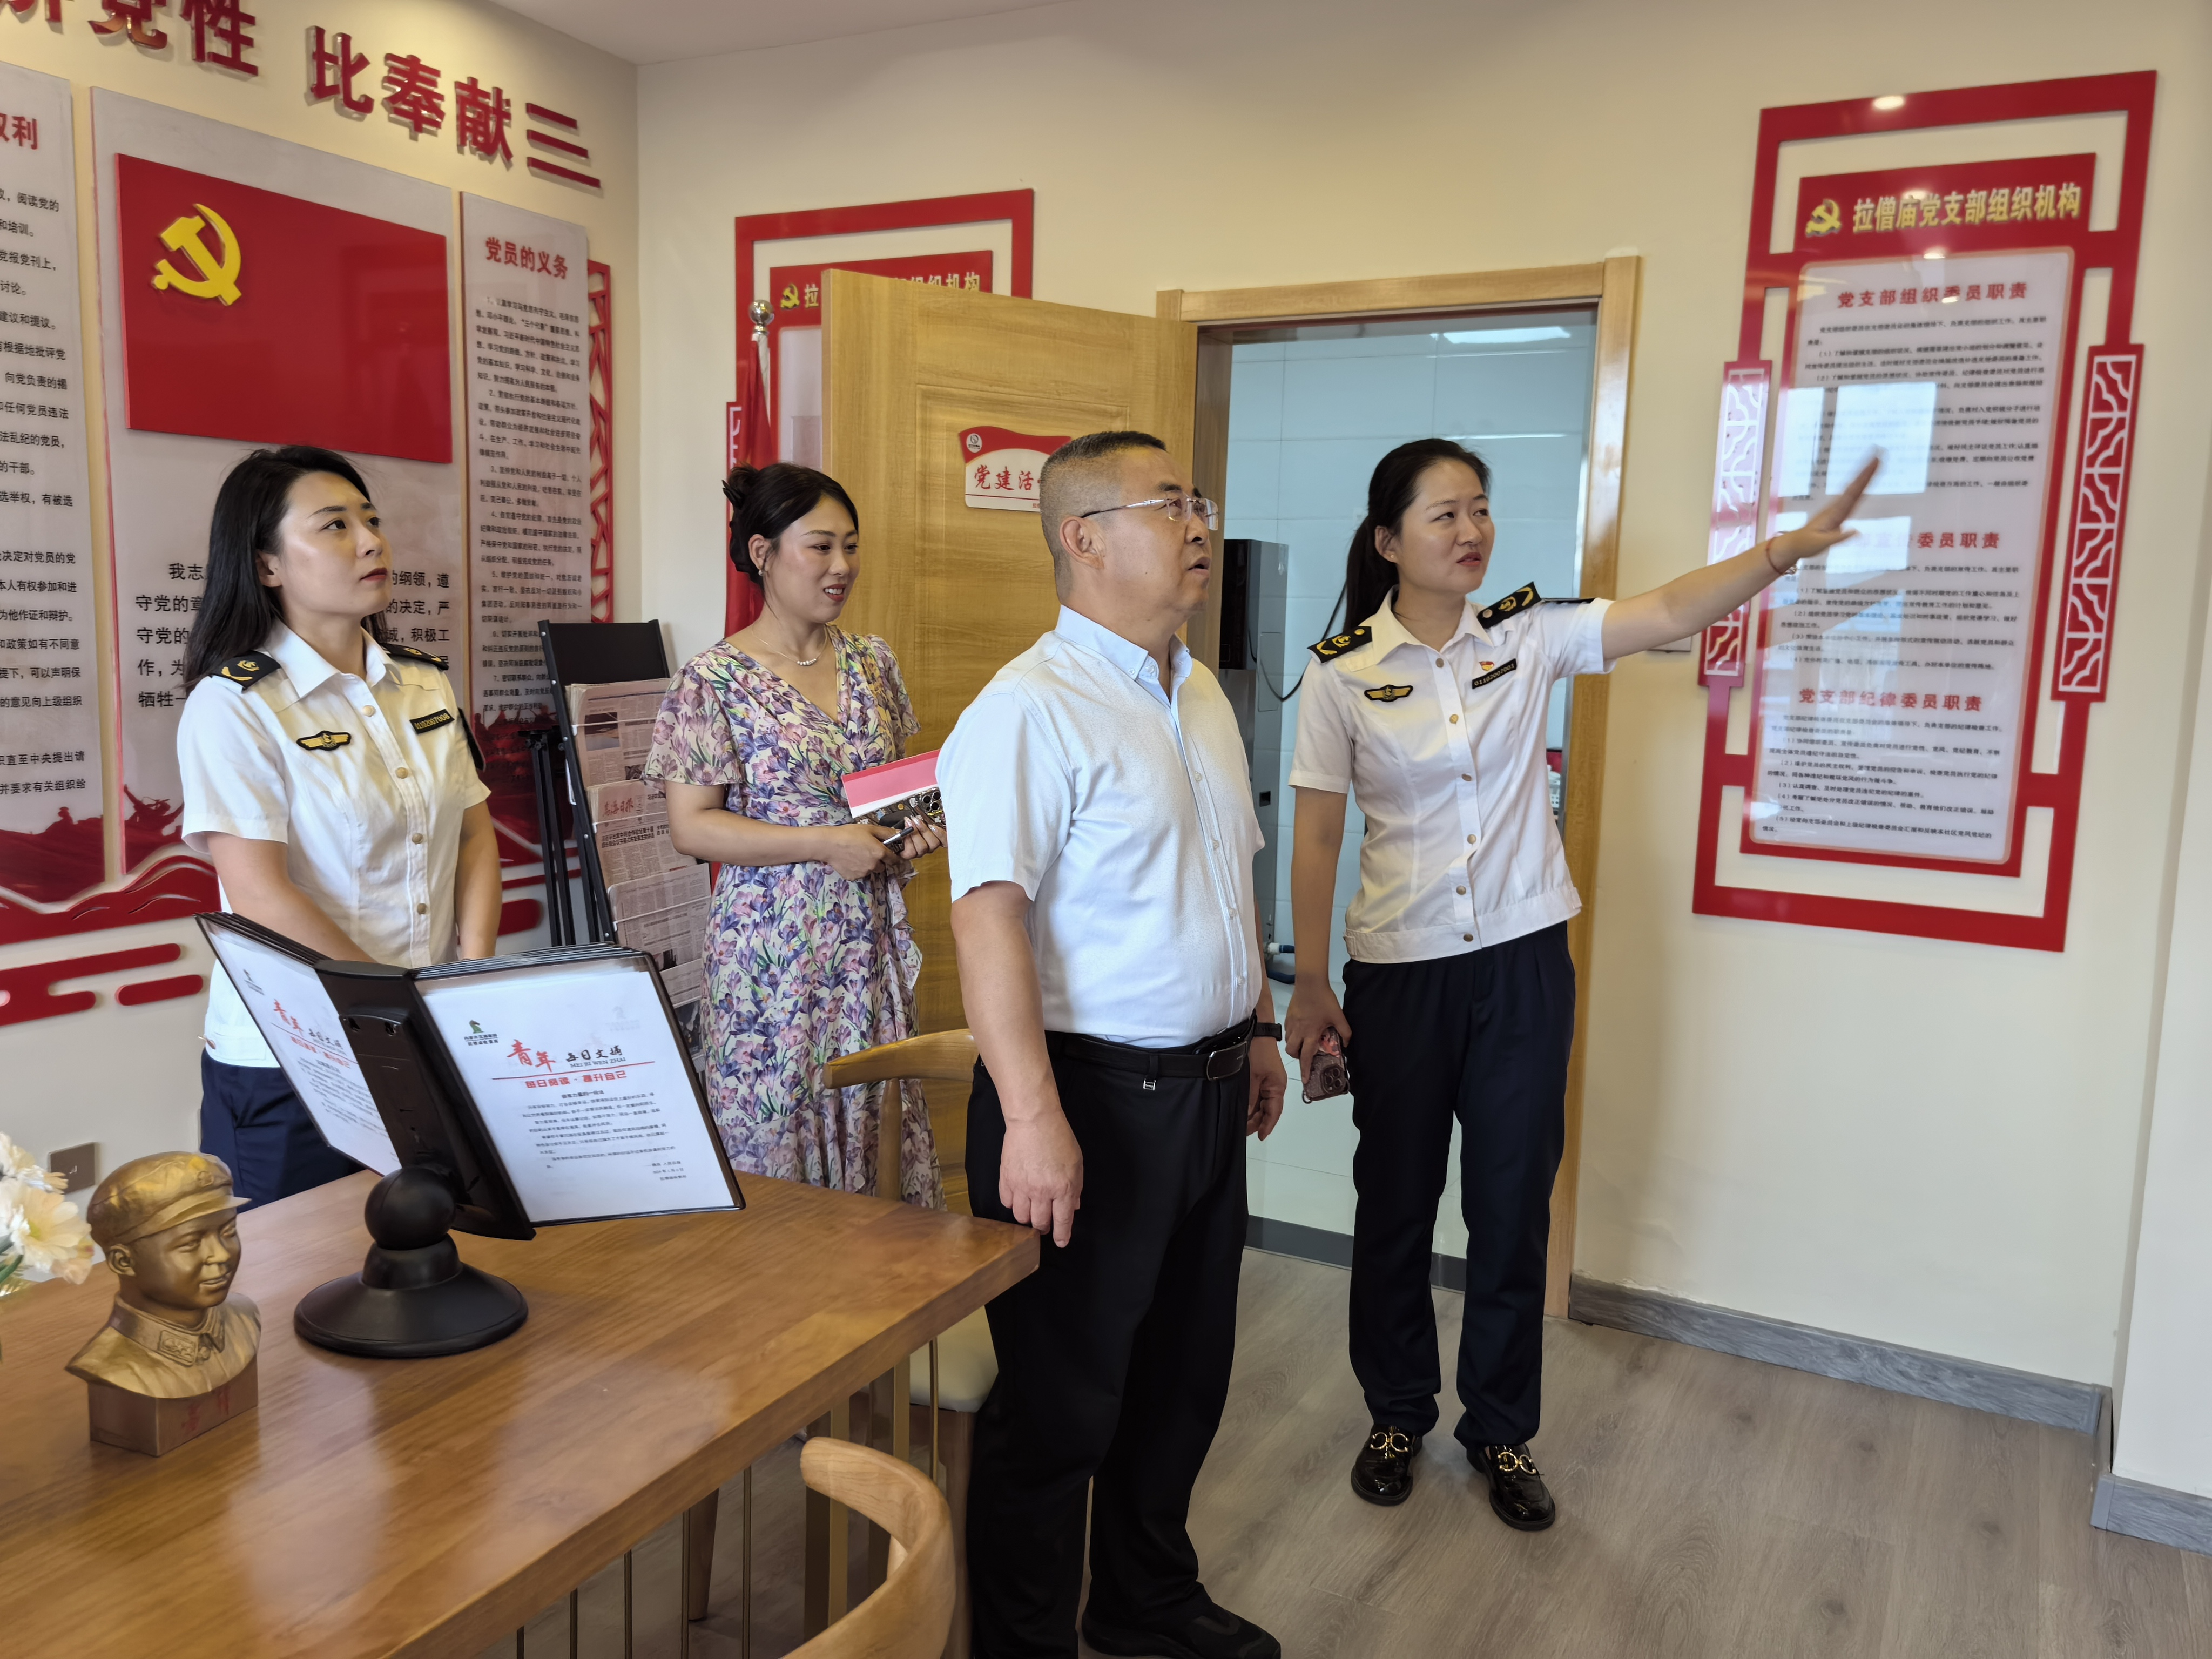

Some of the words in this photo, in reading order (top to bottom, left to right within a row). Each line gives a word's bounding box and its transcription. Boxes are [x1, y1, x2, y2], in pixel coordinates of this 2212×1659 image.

[0, 0, 258, 76] 党性
[1853, 183, 2082, 233] 拉僧庙党支部组织机构
[485, 237, 568, 279] 党员的义务
[1838, 282, 2028, 308] 党支部组织委员职责
[0, 341, 66, 360] 根据地批评党
[974, 464, 1041, 490] 党建活
[0, 550, 76, 564] 决定对党员的党
[168, 563, 208, 581] 我志
[1799, 688, 1982, 711] 党支部纪律委员职责
[507, 1039, 557, 1073] 青年
